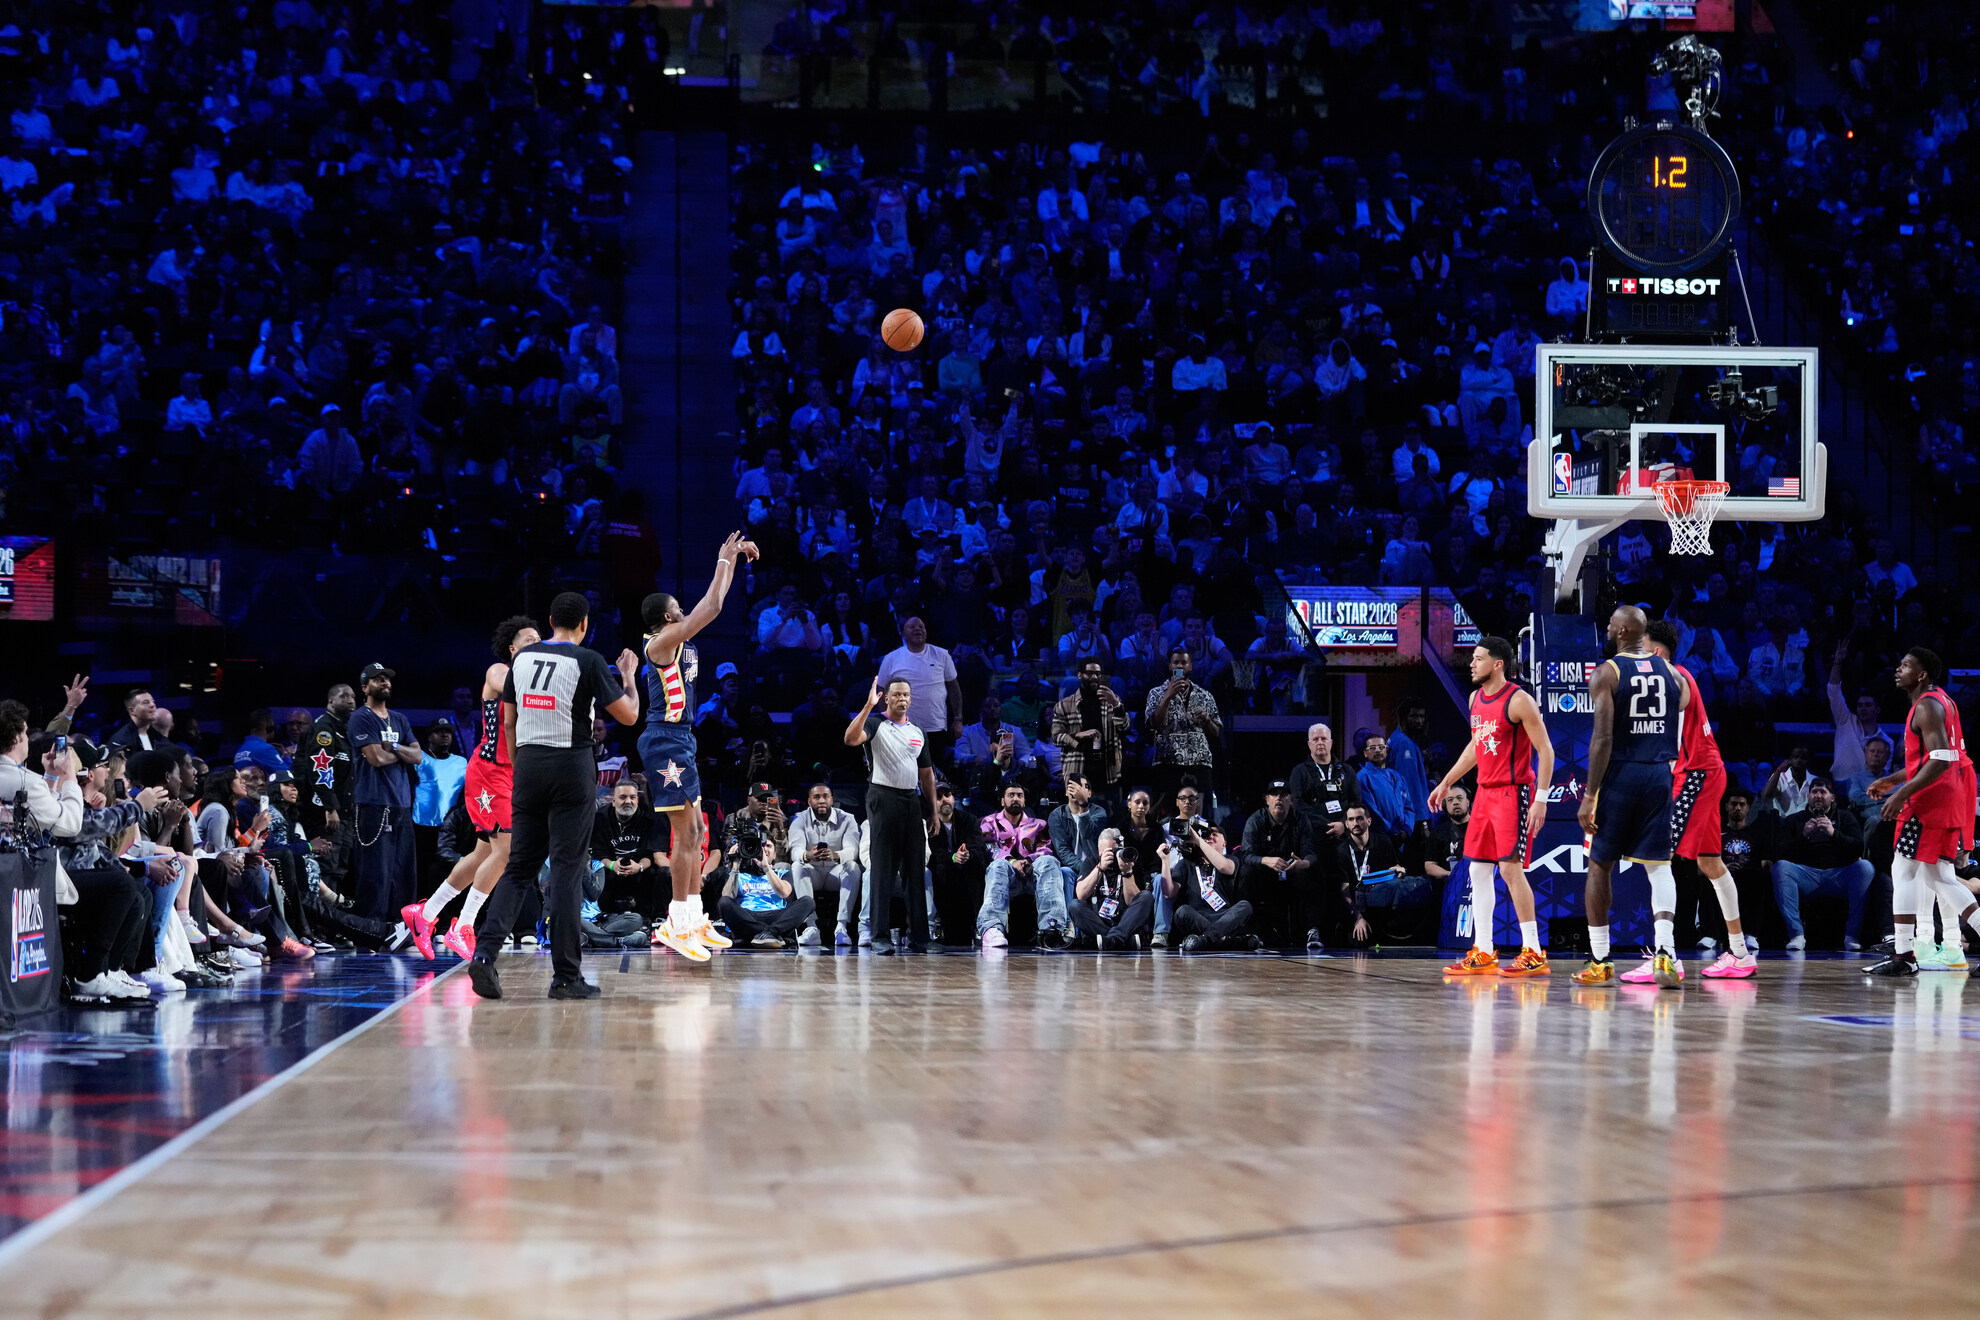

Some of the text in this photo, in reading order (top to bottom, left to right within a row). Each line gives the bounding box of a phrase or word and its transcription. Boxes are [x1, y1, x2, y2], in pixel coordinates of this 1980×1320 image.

[1654, 156, 1687, 188] 1.2
[1639, 278, 1721, 295] TISSOT
[1313, 602, 1398, 625] ALL STAR 2026
[1341, 630, 1394, 645] Los Angeles
[530, 660, 557, 691] 77
[1560, 662, 1583, 683] USA
[525, 697, 553, 707] Emirates
[1629, 675, 1667, 718] 23
[1630, 720, 1666, 734] JAMES
